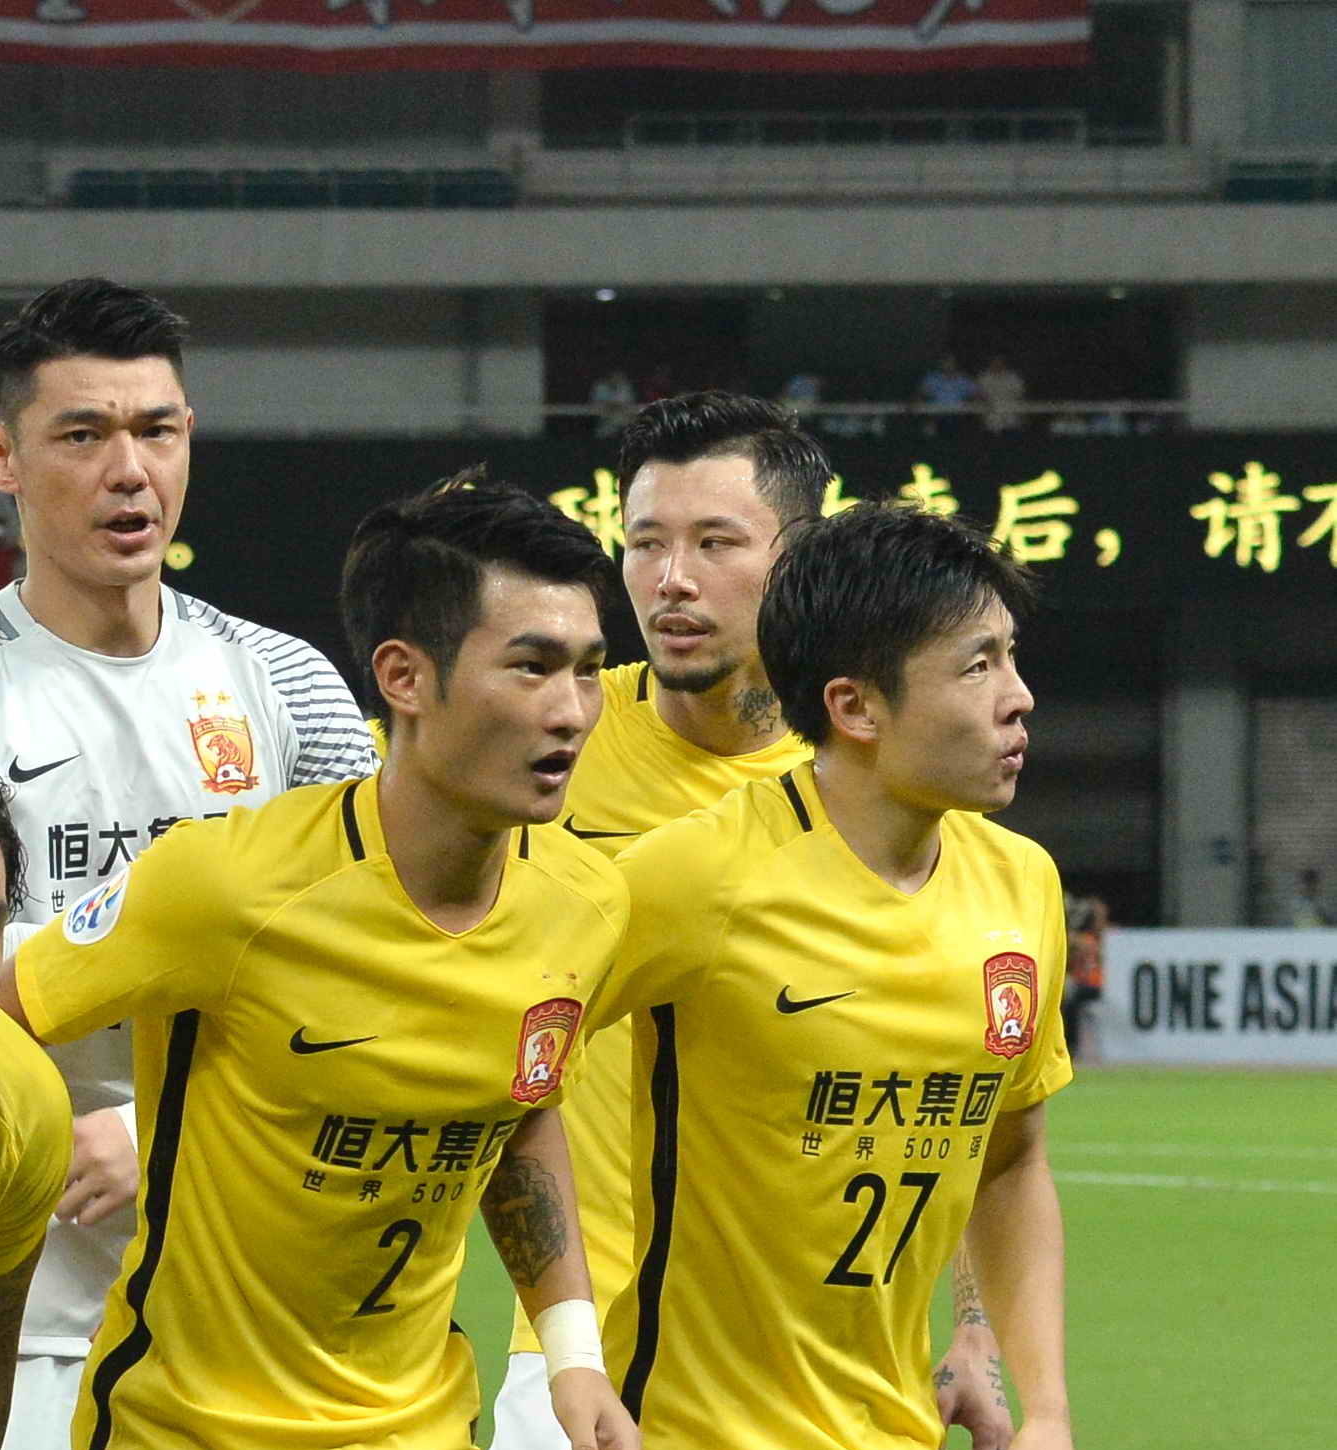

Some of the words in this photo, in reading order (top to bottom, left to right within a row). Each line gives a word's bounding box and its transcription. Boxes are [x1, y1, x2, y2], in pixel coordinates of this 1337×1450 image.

[1131, 961, 1222, 1031] ONE
[804, 1070, 1006, 1128] 恒大集团
[352, 1218, 423, 1319] 2
[823, 1171, 941, 1288] 27
